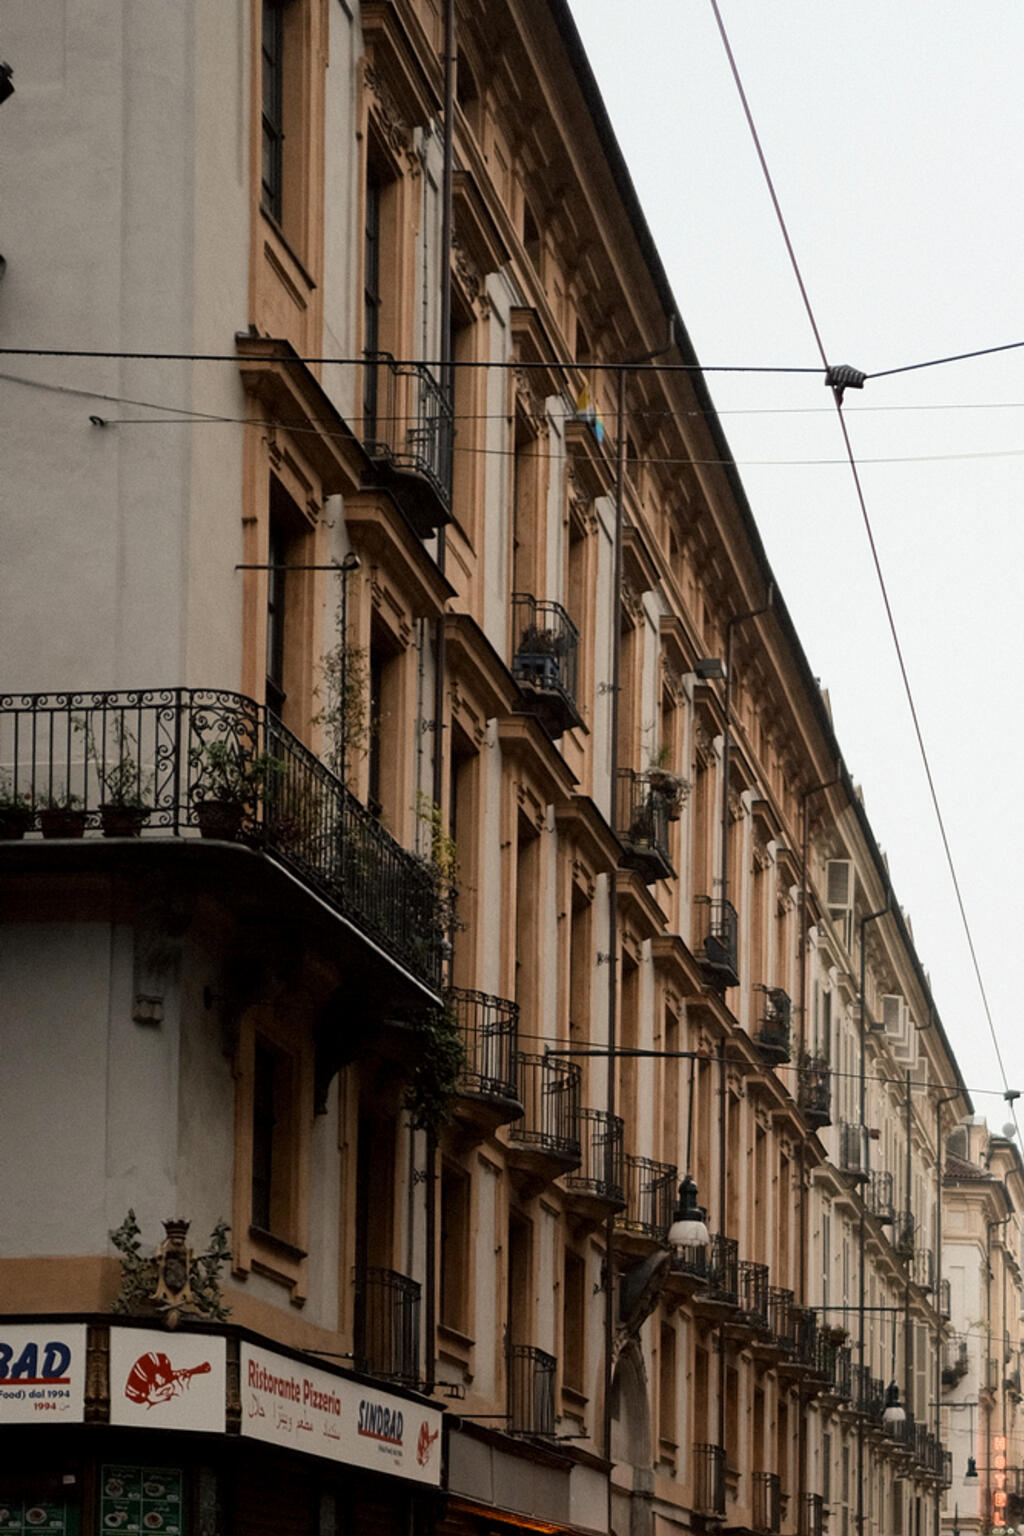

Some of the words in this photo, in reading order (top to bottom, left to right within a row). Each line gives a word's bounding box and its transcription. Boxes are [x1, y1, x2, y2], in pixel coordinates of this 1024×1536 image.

[29, 1389, 45, 1398] dal
[47, 1390, 70, 1398] 1994
[33, 1402, 56, 1410] 1994
[248, 1359, 301, 1402] Ristorante
[303, 1379, 341, 1416] Pizzeria
[358, 1400, 404, 1441] SINDBAD
[993, 1436, 1006, 1527] HOTEL
